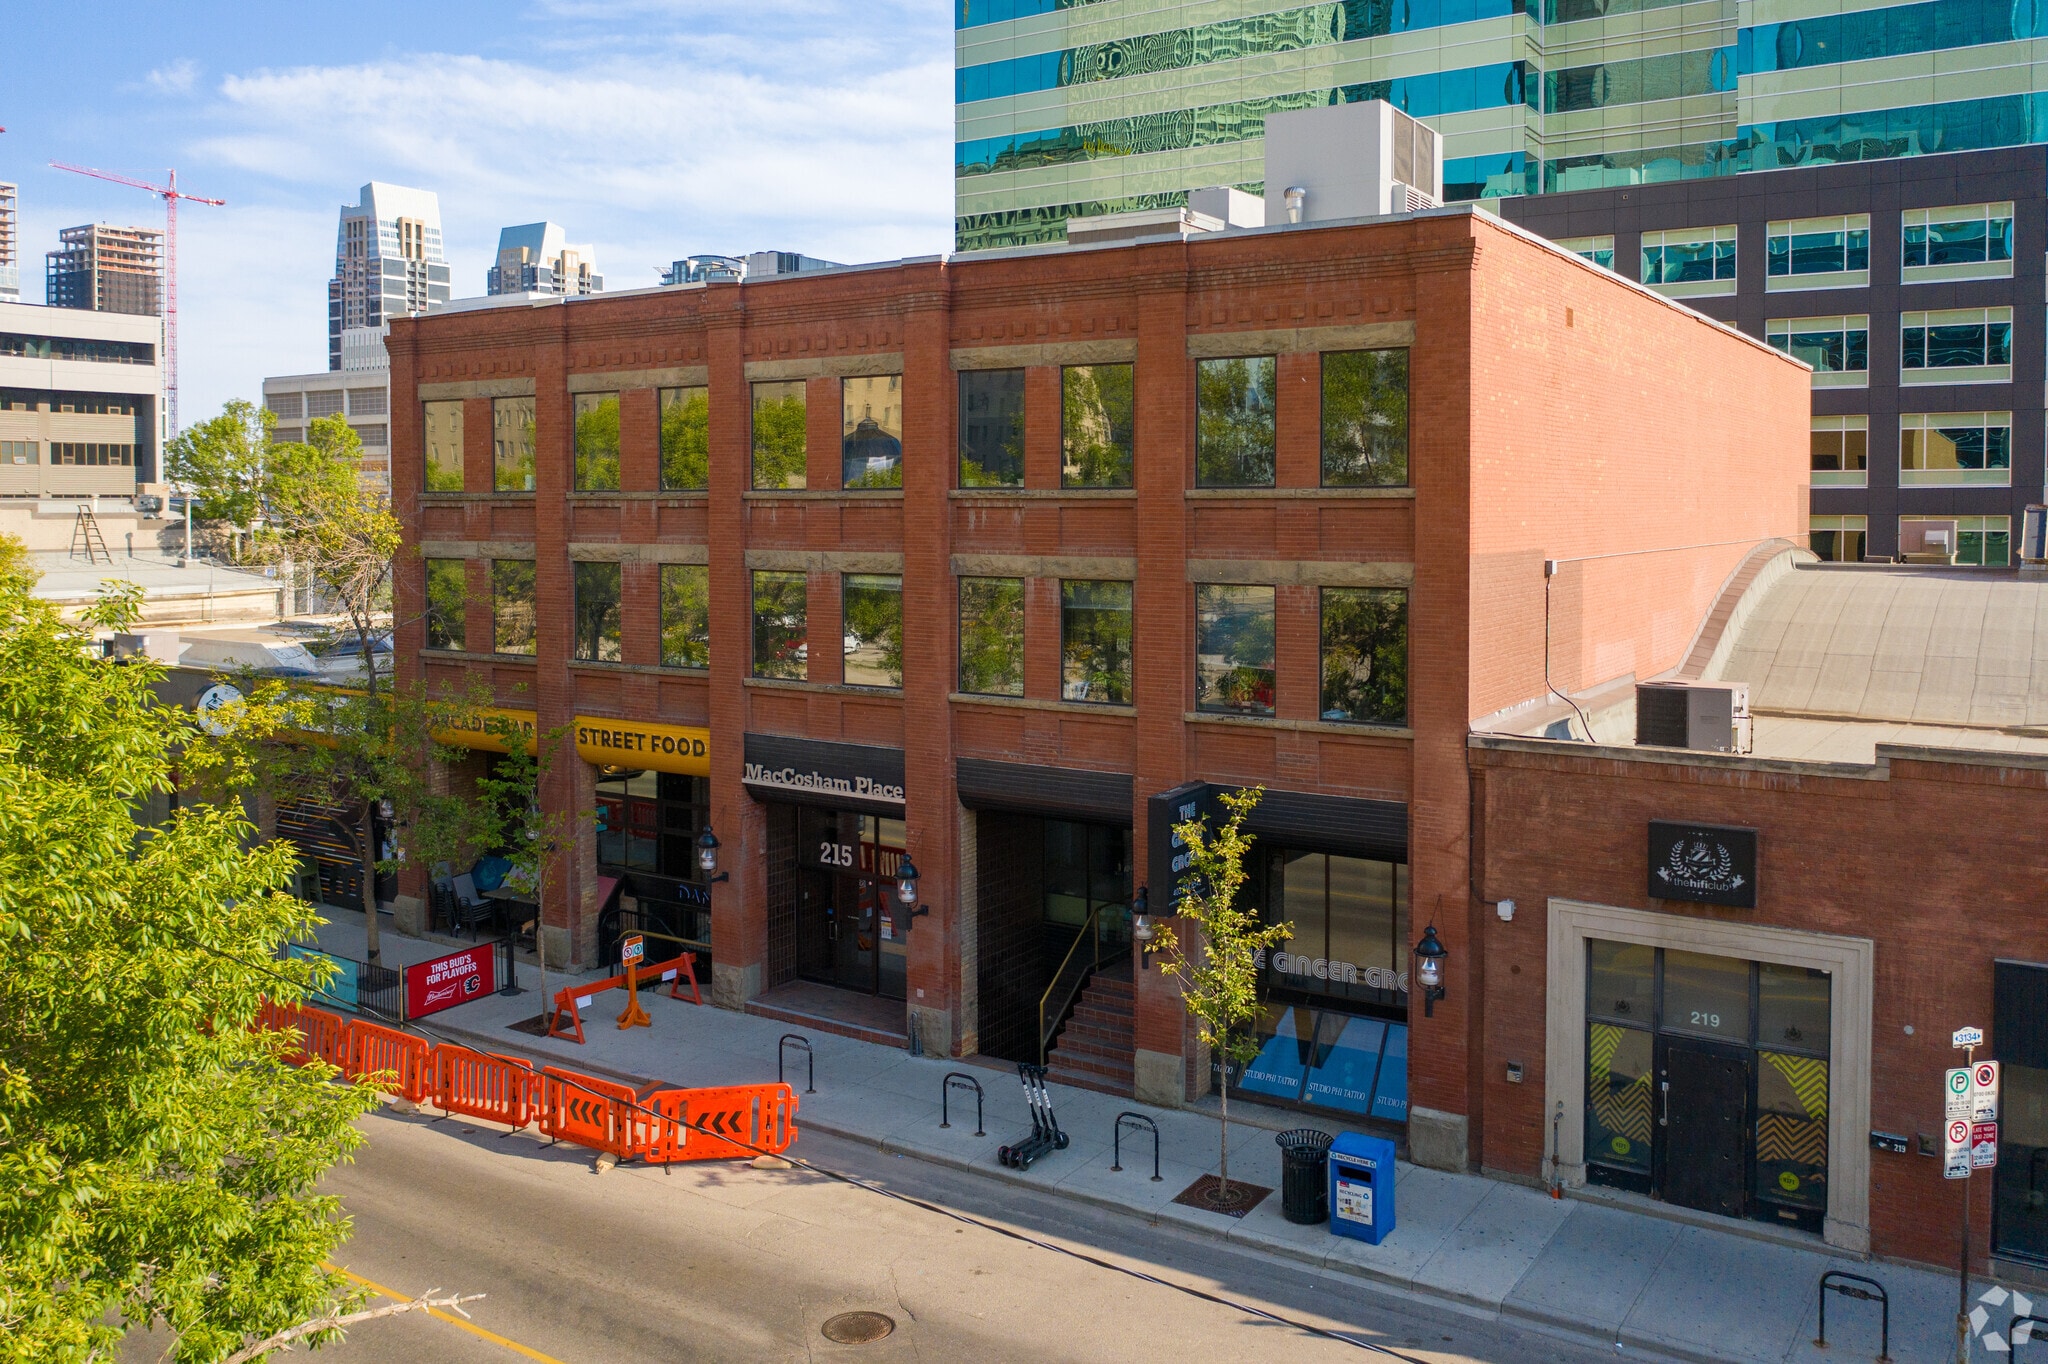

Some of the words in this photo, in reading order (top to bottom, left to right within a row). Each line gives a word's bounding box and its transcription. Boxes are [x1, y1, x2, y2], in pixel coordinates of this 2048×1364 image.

[579, 727, 646, 751] STREET
[651, 735, 706, 757] FOOD
[745, 763, 851, 792] MacCosham
[855, 776, 904, 798] Place
[1179, 801, 1196, 820] THE
[820, 842, 852, 867] 215
[430, 960, 448, 974] THIS
[449, 954, 472, 968] BUD'S
[1273, 952, 1357, 985] GINGER
[426, 975, 441, 986] FOR
[442, 962, 477, 981] PLAYOFFS
[1691, 1011, 1720, 1027] 219
[1958, 1032, 1977, 1042] 3134
[1244, 1069, 1265, 1080] STUDIO
[1265, 1073, 1277, 1082] PHI
[1277, 1075, 1298, 1087] TATTOO
[1309, 1082, 1331, 1094] STUDIO
[1331, 1086, 1342, 1096] PHI
[1343, 1089, 1365, 1101] TATTOO
[1377, 1096, 1399, 1107] STUDIO
[1893, 1143, 1906, 1153] 219
